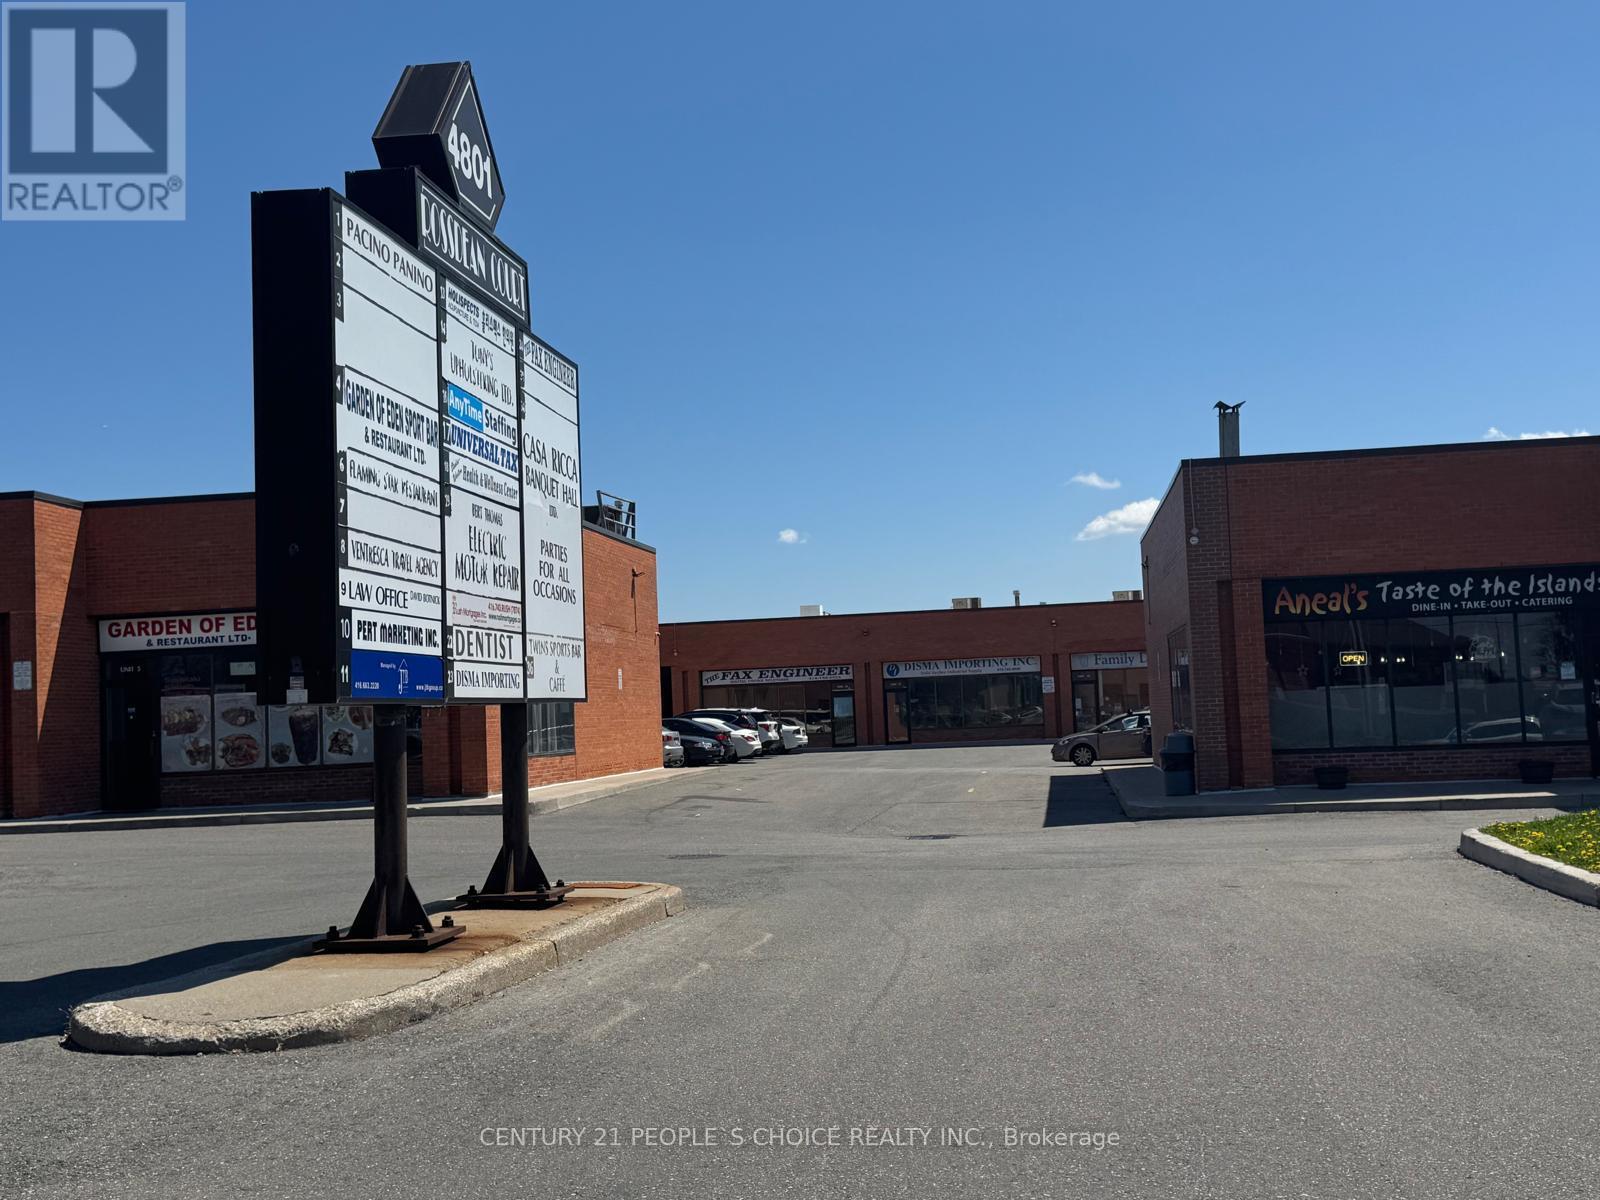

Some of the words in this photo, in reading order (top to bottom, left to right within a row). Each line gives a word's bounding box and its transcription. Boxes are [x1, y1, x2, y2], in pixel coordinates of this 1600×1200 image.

[447, 122, 493, 200] 4801
[335, 212, 341, 226] 1
[335, 252, 341, 267] 2
[347, 217, 390, 264] PACINO
[394, 251, 433, 292] PANINO
[420, 192, 487, 281] ROSSDEAN
[490, 252, 526, 312] COURT
[336, 293, 342, 308] 3
[447, 286, 480, 318] HOLISPECTS
[531, 341, 543, 370] FAX
[544, 350, 575, 390] ENGINEER
[345, 379, 375, 421] GARDEN
[376, 393, 385, 425] OF
[386, 398, 404, 433] EDEN
[405, 406, 424, 443] SPORT
[426, 417, 439, 449] BAR
[450, 389, 482, 422] AnyTime
[484, 408, 516, 446] Staffing
[365, 426, 369, 443] &
[371, 429, 412, 461] RESTAURANT
[414, 446, 427, 465] LTD.
[452, 424, 500, 465] UNIVERSAL
[501, 448, 518, 473] TAX
[523, 432, 548, 468] CASA
[552, 447, 578, 483] RICCA
[340, 458, 345, 472] 6
[350, 459, 380, 488] FLAMING
[463, 465, 479, 486] Health
[483, 473, 503, 495] Wellness
[504, 482, 518, 500] Center
[526, 465, 559, 499] BANQUET
[562, 484, 579, 508] HALL
[340, 498, 345, 513] 7
[341, 539, 346, 553] 8
[469, 524, 507, 561] ELECTRIC
[540, 539, 568, 563] PARTIES
[351, 540, 389, 567] VENTRESCA
[392, 550, 413, 573] TRAVEL
[415, 556, 439, 578] AGENCY
[455, 552, 488, 584] MOTOR
[493, 561, 519, 591] REPAIR
[539, 560, 554, 579] FOR
[558, 566, 570, 583] ALL
[341, 582, 346, 596] 9
[349, 581, 373, 603] LAW
[376, 586, 408, 609] OFFICE
[410, 590, 422, 602] DAVID
[533, 579, 576, 605] OCCASIONS
[1274, 582, 1369, 616] Aneal's
[1376, 580, 1440, 602] Taste
[1450, 577, 1474, 598] of
[1481, 576, 1521, 596] the
[1412, 602, 1451, 612] DINE-IN
[1461, 599, 1511, 609] TAKE-OUT
[1522, 596, 1573, 606] CATERING
[108, 619, 192, 638] GARDEN
[200, 617, 226, 633] OF
[340, 618, 350, 639] 10
[357, 619, 378, 642] PERT
[380, 622, 423, 647] MARKETING
[425, 628, 439, 648] INC.
[146, 639, 153, 647] &
[156, 635, 226, 647] RESTAURANT
[455, 629, 513, 660] DENTIST
[529, 639, 549, 656] TWINS
[550, 641, 570, 658] SPORTS
[572, 644, 581, 658] BAR
[555, 660, 560, 674] &
[904, 660, 939, 671] DISMA
[944, 658, 1008, 670] IMPORTING
[1094, 652, 1134, 666] Family
[341, 665, 349, 683] 11
[456, 670, 480, 687] DISMA
[482, 671, 520, 689] IMPORTING
[705, 673, 720, 684] THE
[720, 671, 753, 681] FAX
[759, 666, 850, 679] ENGINEER
